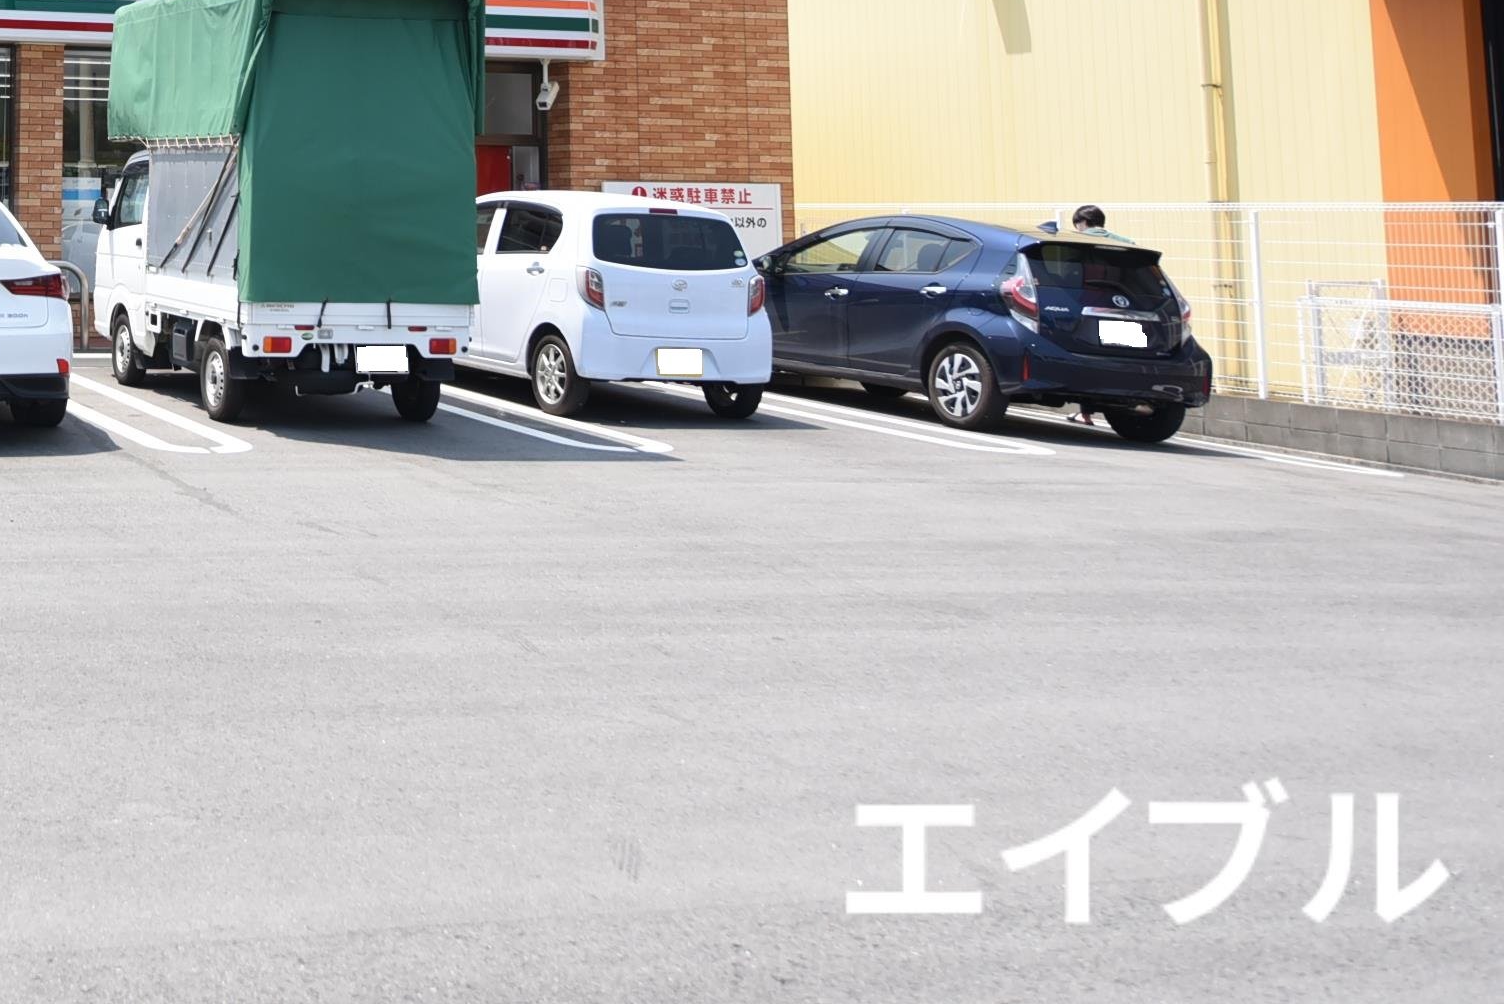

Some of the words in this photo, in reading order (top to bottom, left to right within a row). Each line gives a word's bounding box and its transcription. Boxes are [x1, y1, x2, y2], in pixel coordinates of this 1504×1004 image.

[652, 187, 753, 204] 迷惑駐車禁止
[730, 217, 767, 228] 以外の
